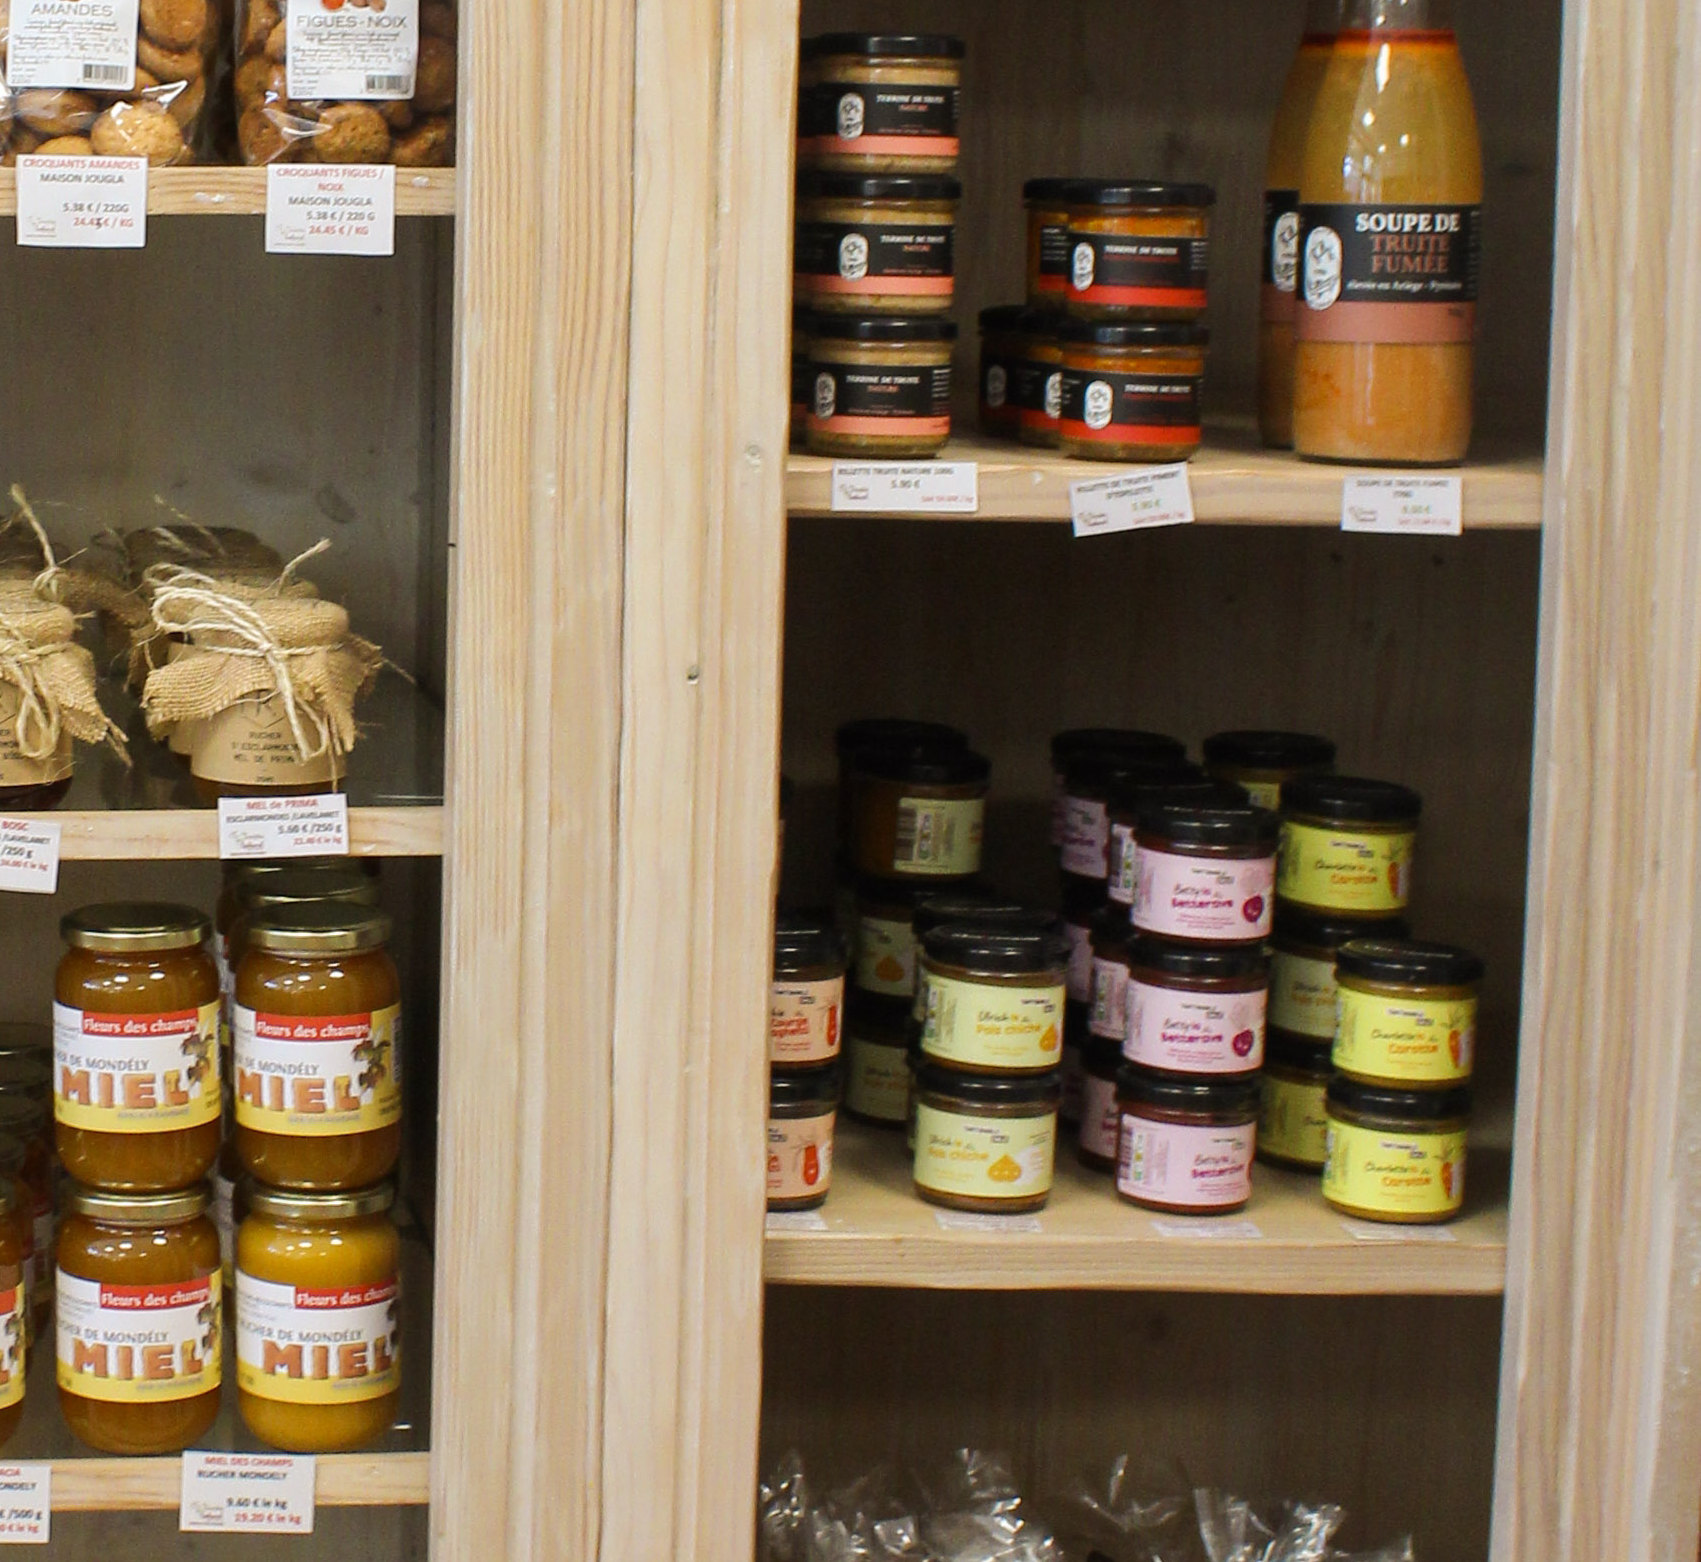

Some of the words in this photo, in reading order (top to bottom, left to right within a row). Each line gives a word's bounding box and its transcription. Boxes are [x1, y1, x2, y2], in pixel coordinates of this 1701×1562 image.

[31, 3, 113, 16] AMANDES
[1355, 212, 1432, 233] SOUPE
[1434, 213, 1460, 232] DE
[1370, 234, 1450, 252] TRUITE
[83, 1017, 122, 1033] Fleurs
[124, 1020, 148, 1033] des
[256, 1020, 292, 1037] Fleurs
[296, 1025, 318, 1039] des
[61, 1065, 189, 1109] MIEL
[238, 1067, 360, 1113] MIEL
[101, 1292, 142, 1307] Fleurs
[144, 1292, 168, 1307] des
[296, 1291, 338, 1307] Fleurs
[340, 1291, 362, 1306] des
[72, 1337, 203, 1380] MIEL
[262, 1335, 393, 1380] MIEL
